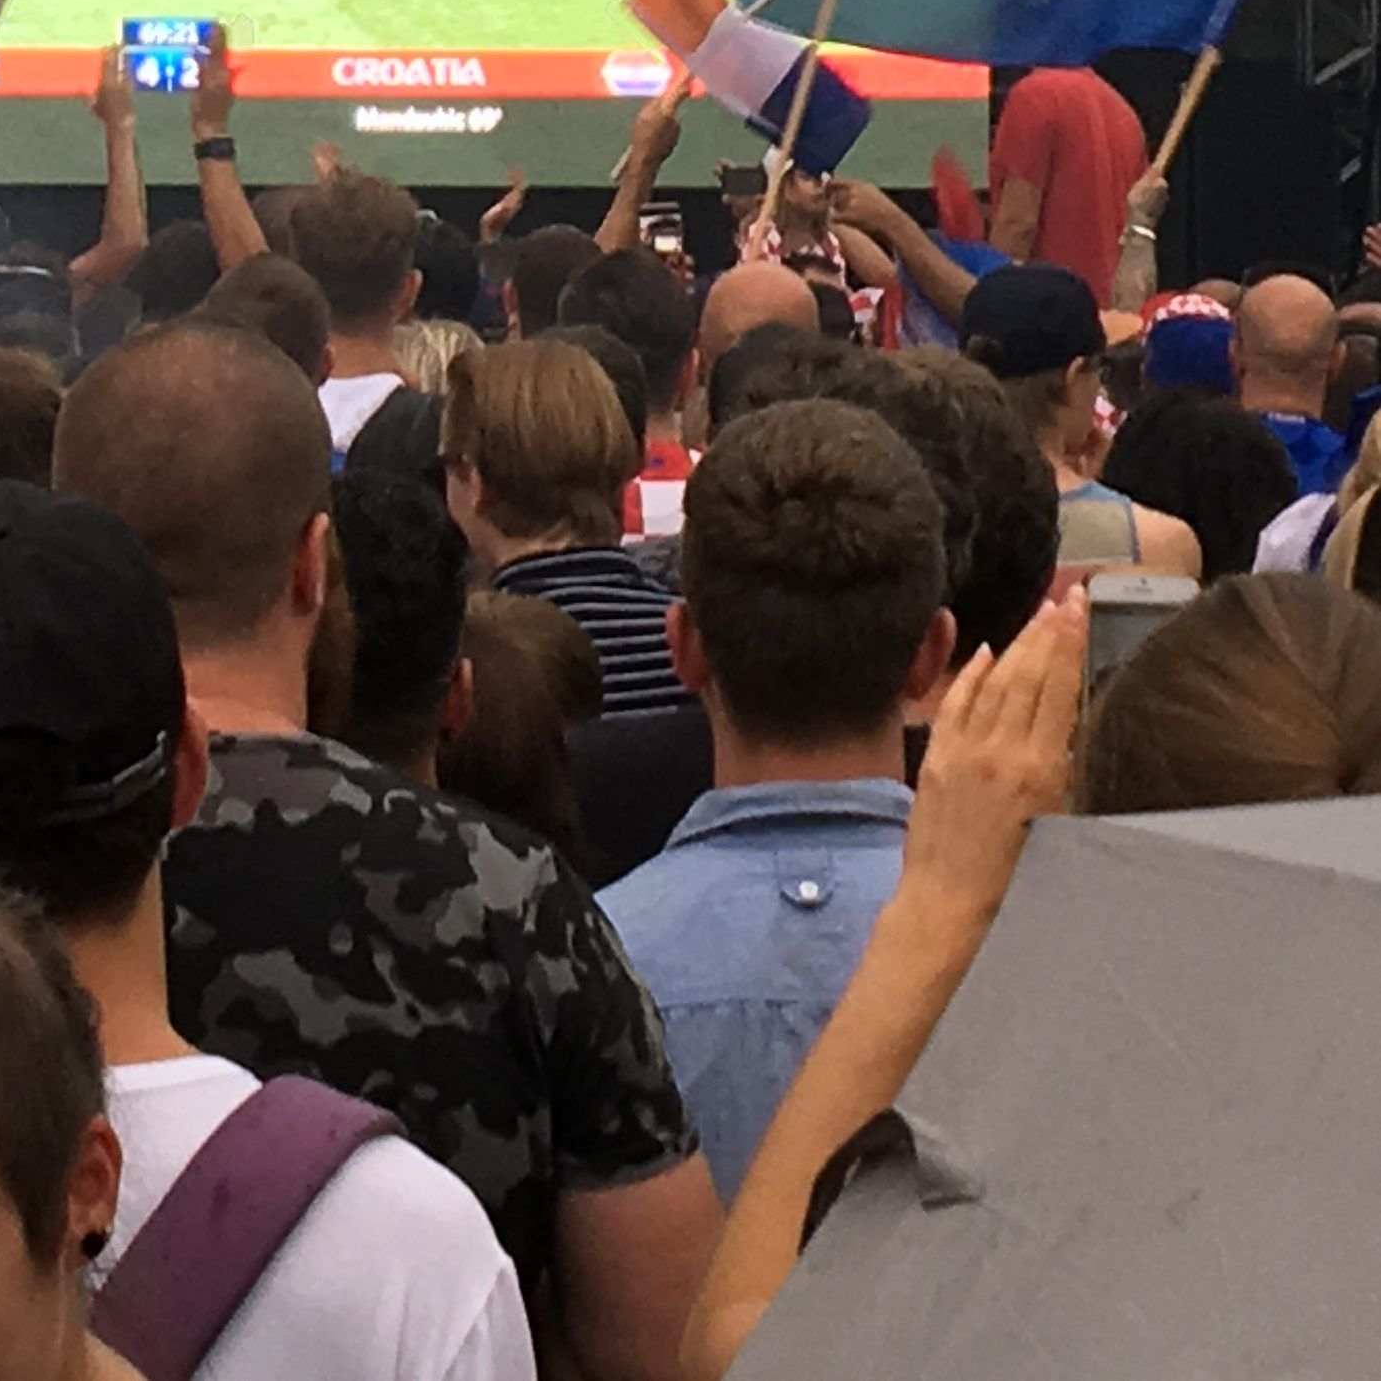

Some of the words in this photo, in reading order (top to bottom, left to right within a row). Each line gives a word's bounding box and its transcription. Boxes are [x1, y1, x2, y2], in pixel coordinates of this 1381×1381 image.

[136, 56, 160, 88] 4
[180, 56, 200, 88] 2
[331, 57, 486, 87] CROATIA
